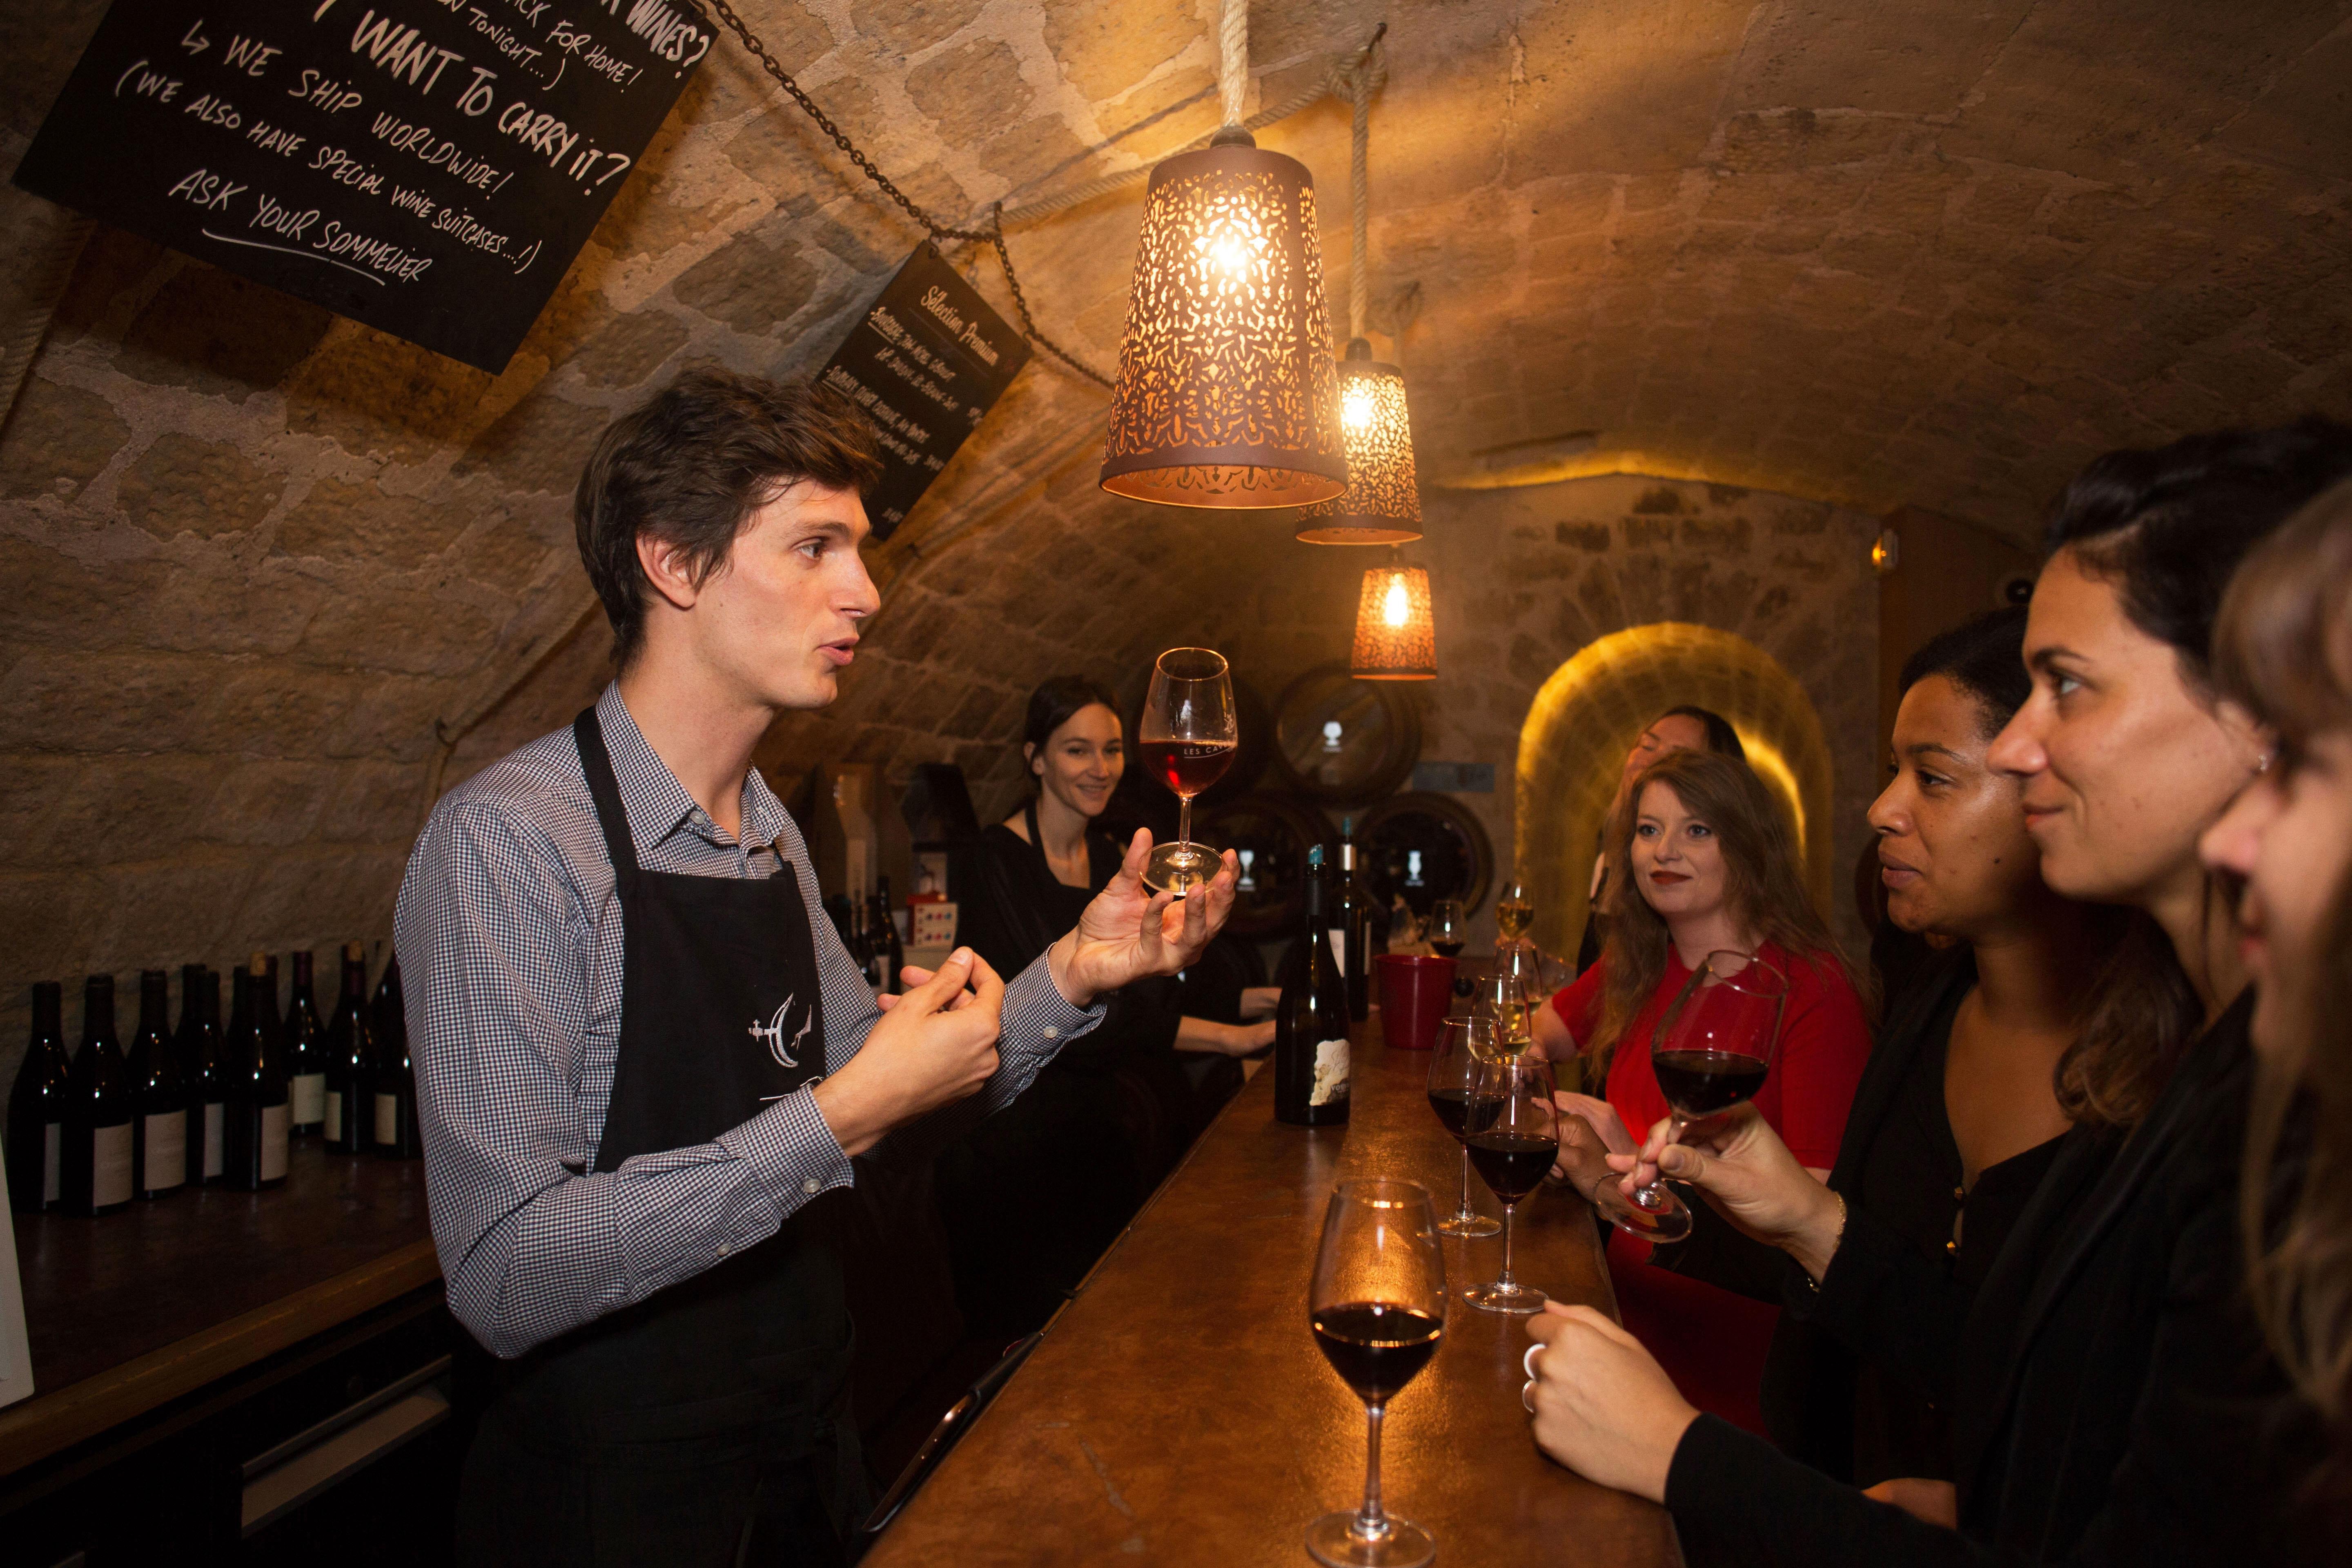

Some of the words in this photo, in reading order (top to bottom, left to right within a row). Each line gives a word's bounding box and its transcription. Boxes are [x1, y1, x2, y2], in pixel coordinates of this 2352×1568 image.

[350, 10, 465, 95] WANT
[456, 67, 498, 116] TO
[498, 102, 579, 168] CARRY
[546, 20, 591, 54] FOR
[584, 45, 643, 94] HOME!
[626, 0, 709, 79] WINES?
[115, 60, 183, 102] (WE
[184, 94, 241, 129] ALSO
[246, 121, 306, 156] HAVE
[308, 146, 385, 195] SPECIAL
[391, 185, 436, 218] WINE
[223, 35, 283, 76] WE
[287, 69, 363, 114] SHIP
[371, 111, 514, 200] WORLDWIDE!
[168, 169, 248, 210] ASK
[249, 194, 321, 241] YOUR
[313, 221, 433, 283] SOMMELIER
[921, 286, 964, 334] Sélection
[958, 321, 1000, 366] Premium
